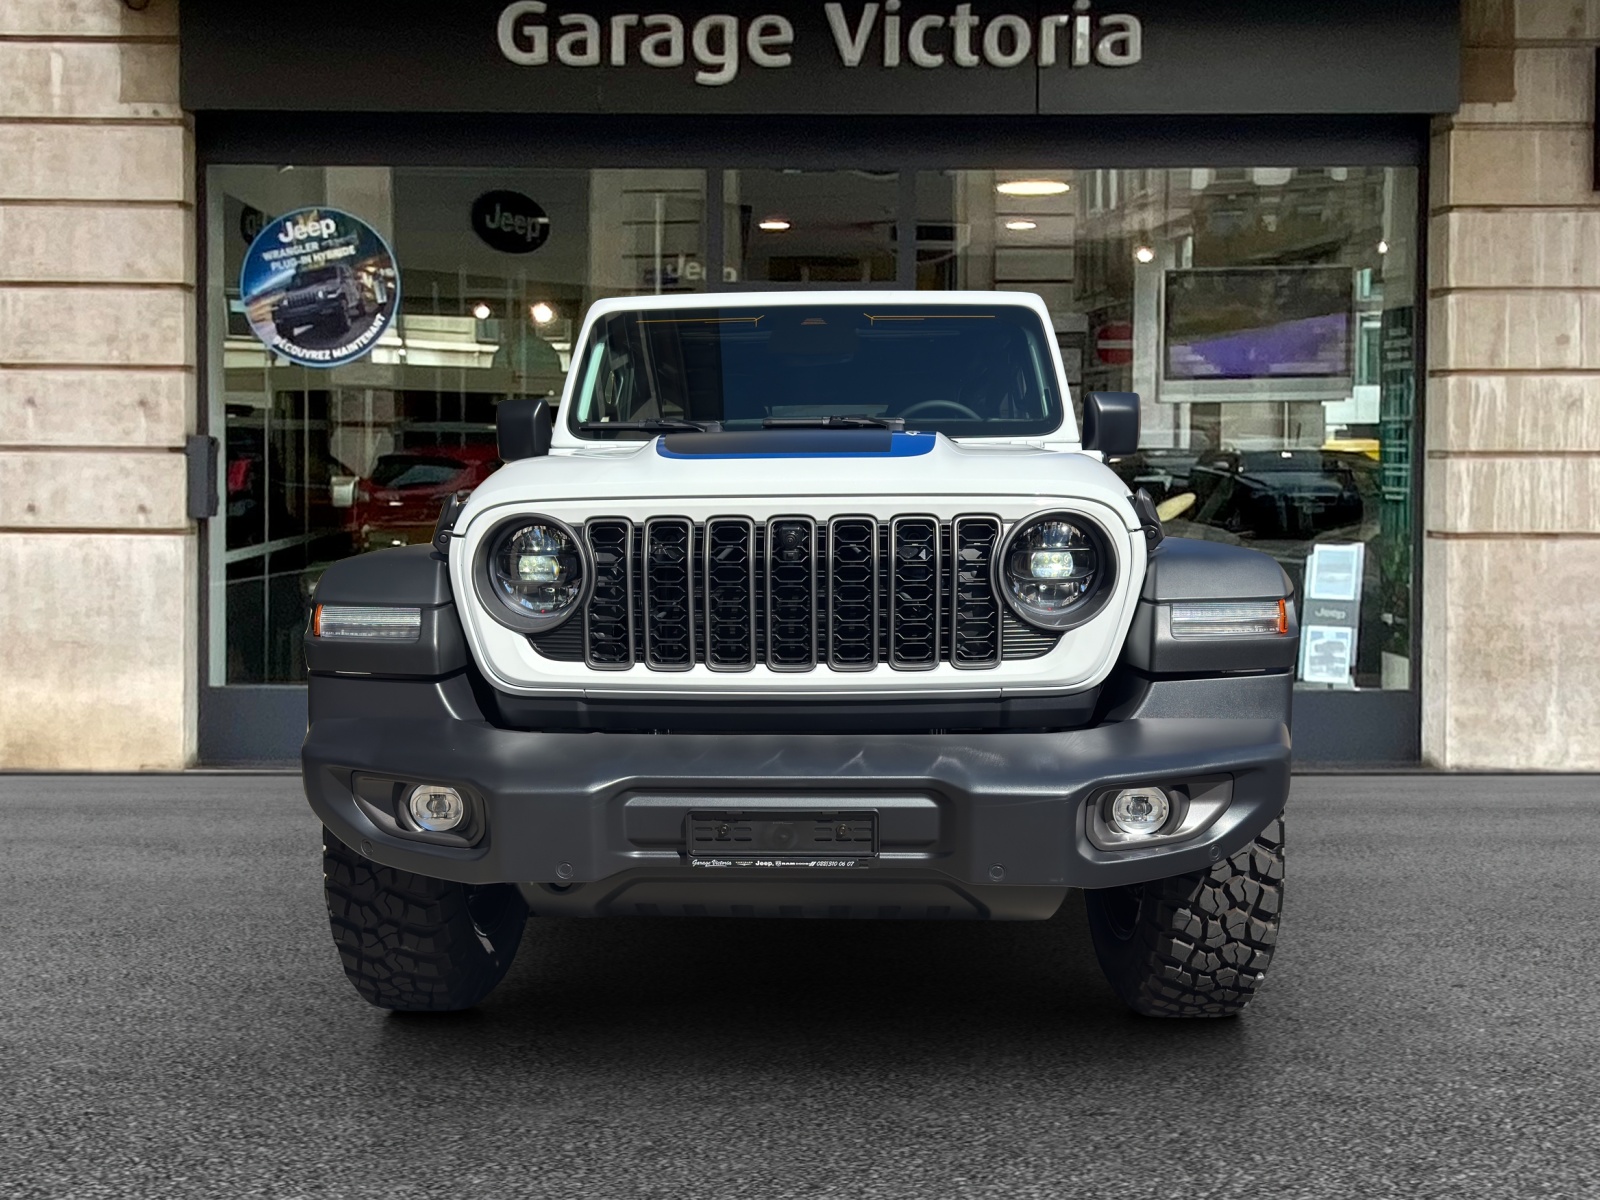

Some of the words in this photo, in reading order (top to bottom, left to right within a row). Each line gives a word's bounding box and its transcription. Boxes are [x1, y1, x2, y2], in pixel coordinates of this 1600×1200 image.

[497, 0, 795, 86] Garage
[825, 0, 1143, 68] Victoria
[278, 217, 337, 243] Jeep
[485, 202, 541, 242] Jeep
[262, 241, 320, 262] WRANGLER
[270, 254, 312, 272] PLUG-IN
[1314, 607, 1347, 620] Jeep
